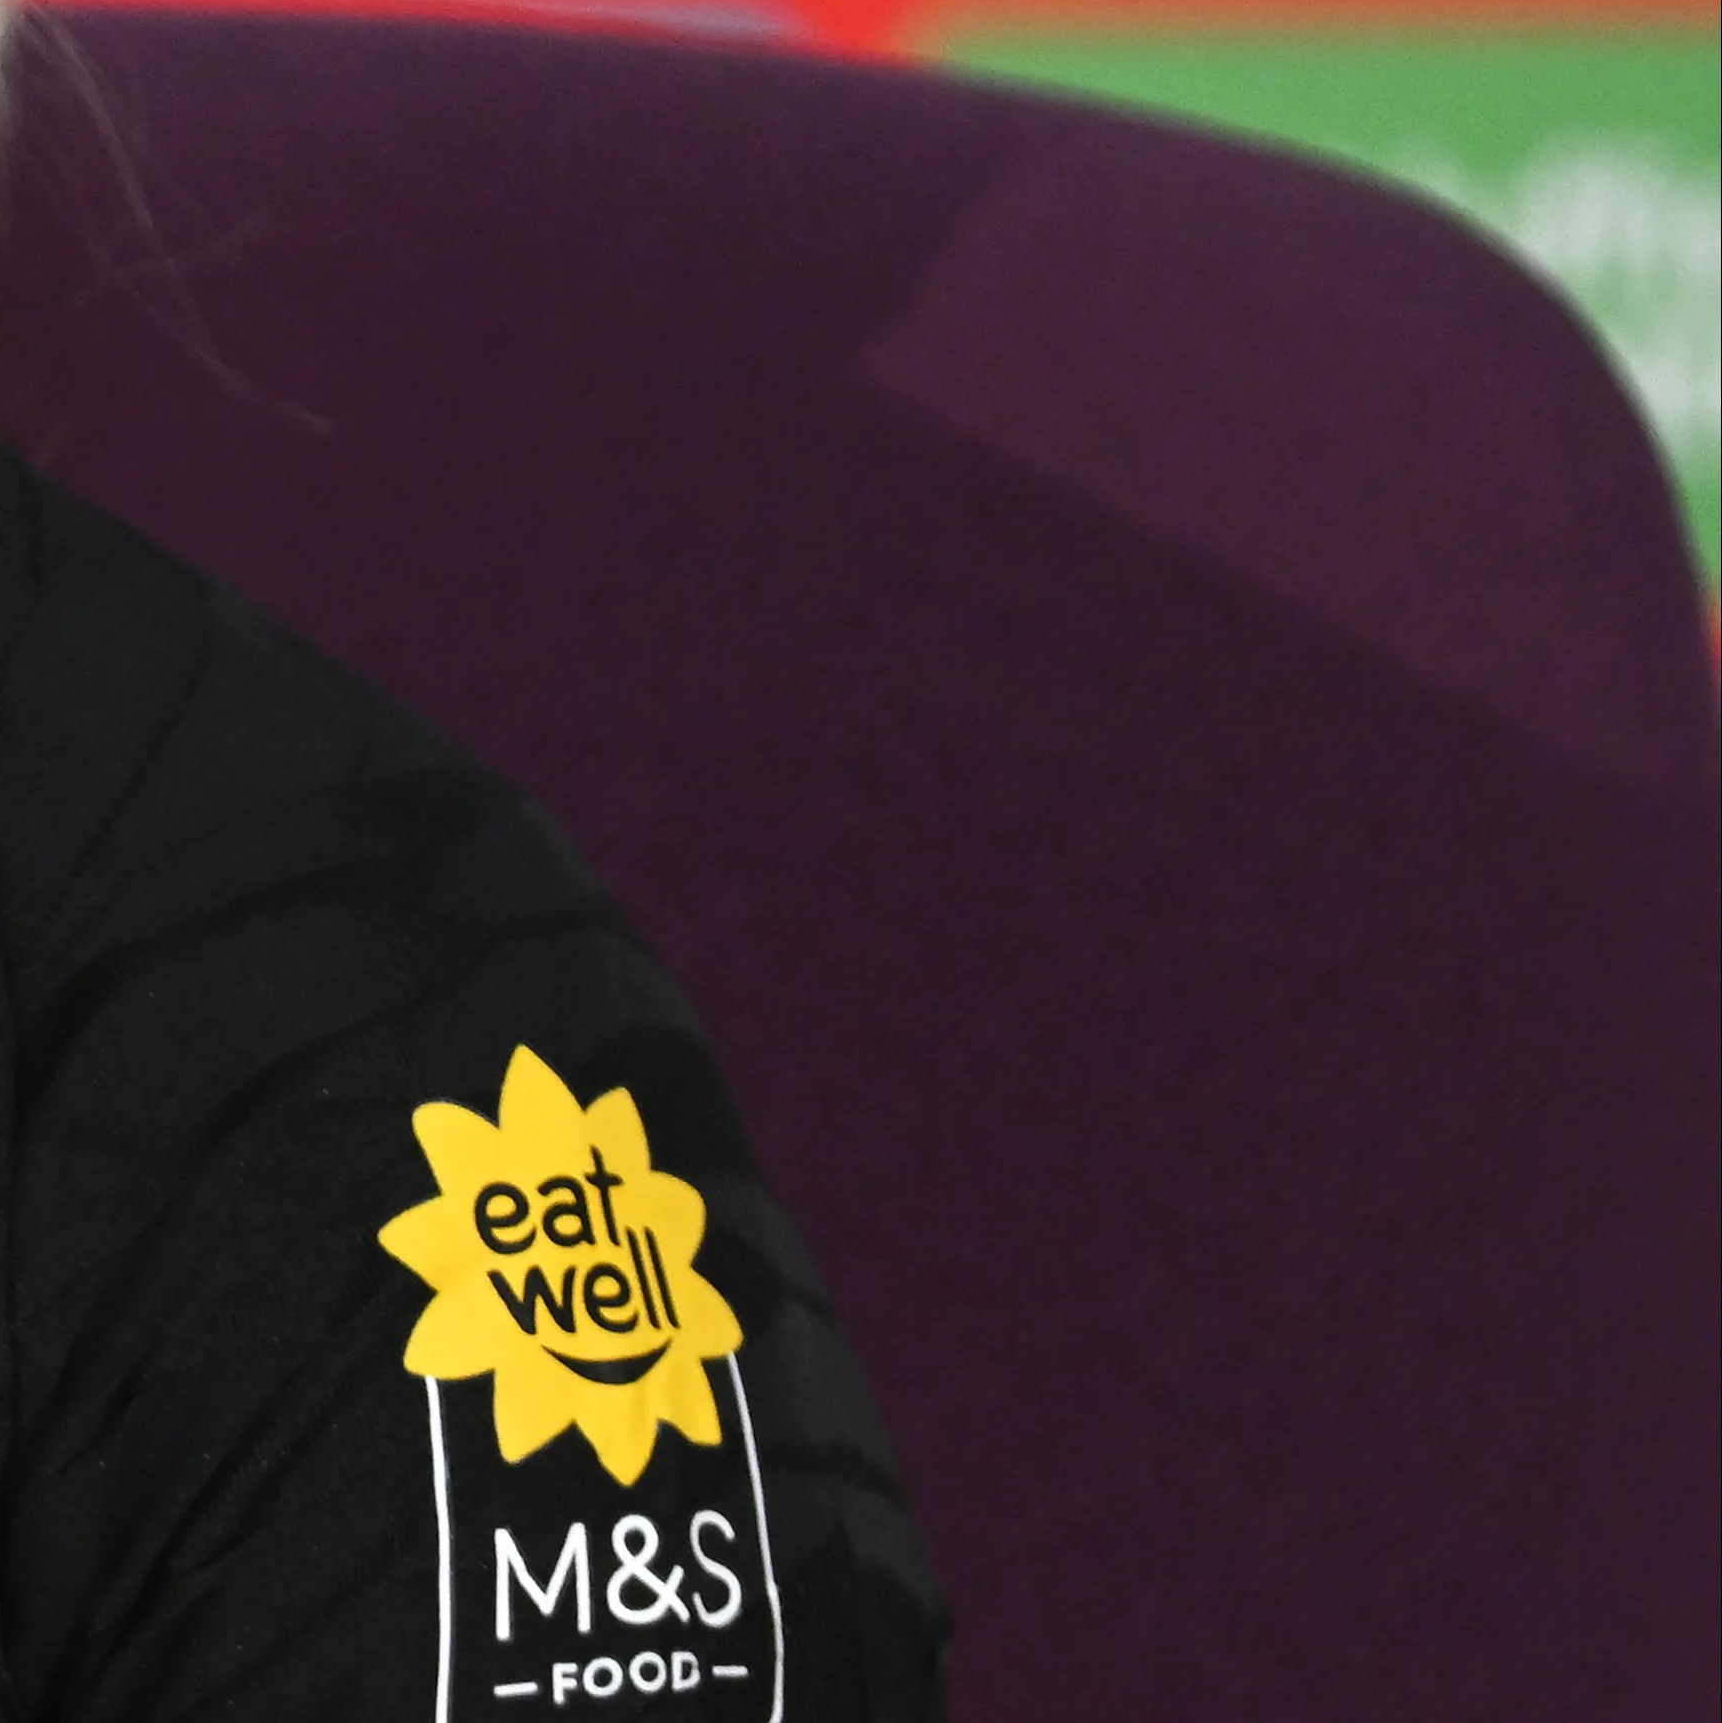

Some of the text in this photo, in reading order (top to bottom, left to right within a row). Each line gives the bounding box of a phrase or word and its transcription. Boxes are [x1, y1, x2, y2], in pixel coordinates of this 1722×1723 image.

[474, 1144, 625, 1254] eat
[486, 1225, 681, 1336] well
[493, 1509, 744, 1642] M&S
[551, 1650, 702, 1705] FOOD
